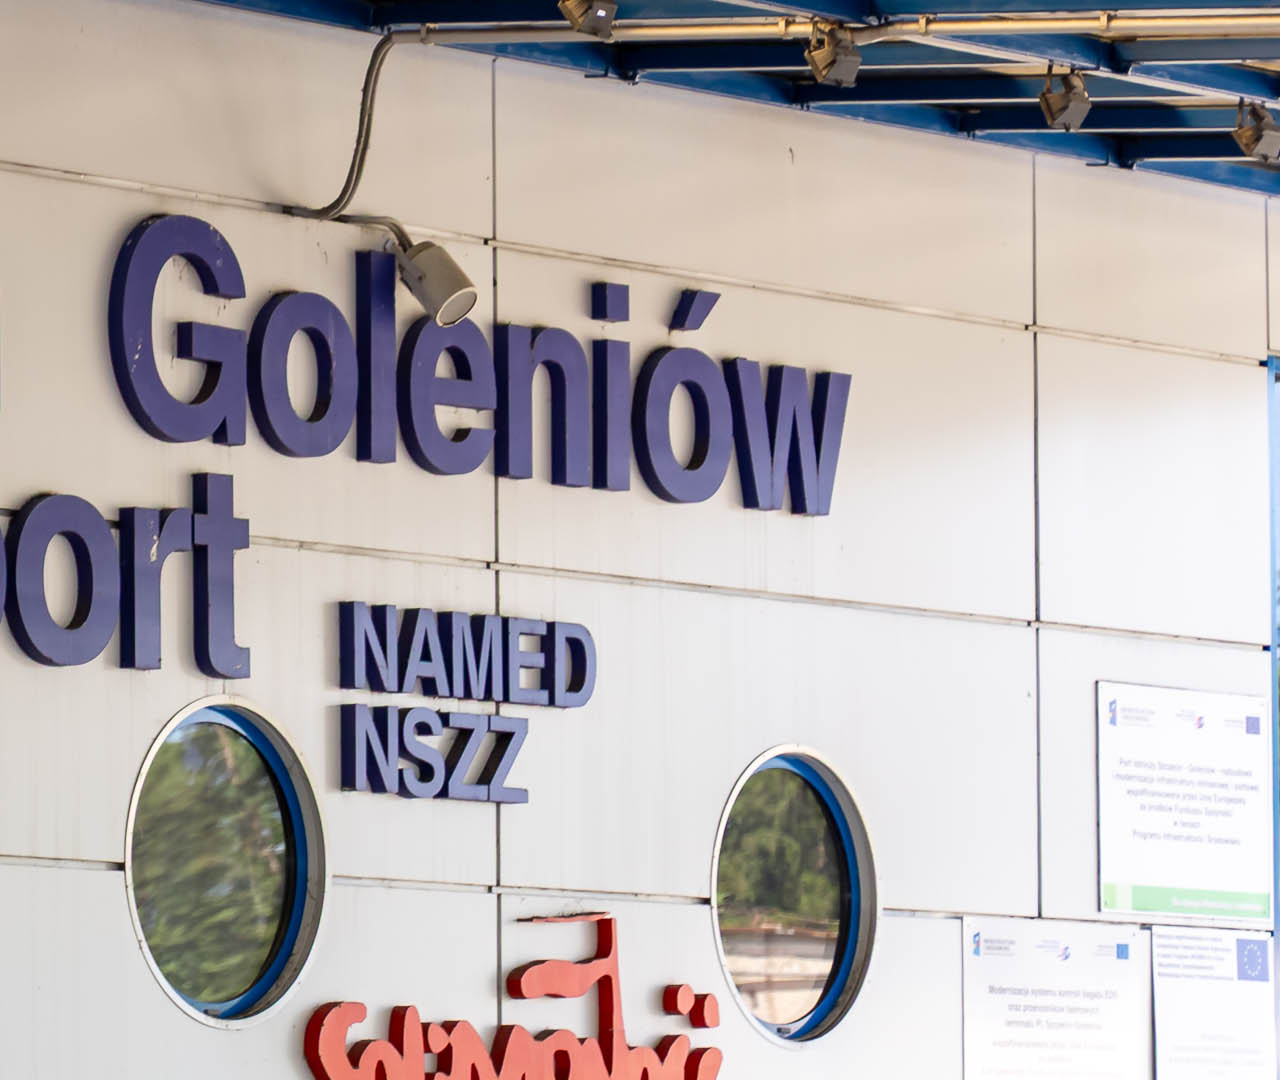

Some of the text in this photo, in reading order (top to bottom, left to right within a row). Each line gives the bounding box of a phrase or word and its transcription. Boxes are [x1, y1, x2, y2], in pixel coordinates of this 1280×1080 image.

[108, 214, 852, 516] Goleniów
[339, 601, 597, 708] NAMED
[339, 703, 529, 803] NSZZ
